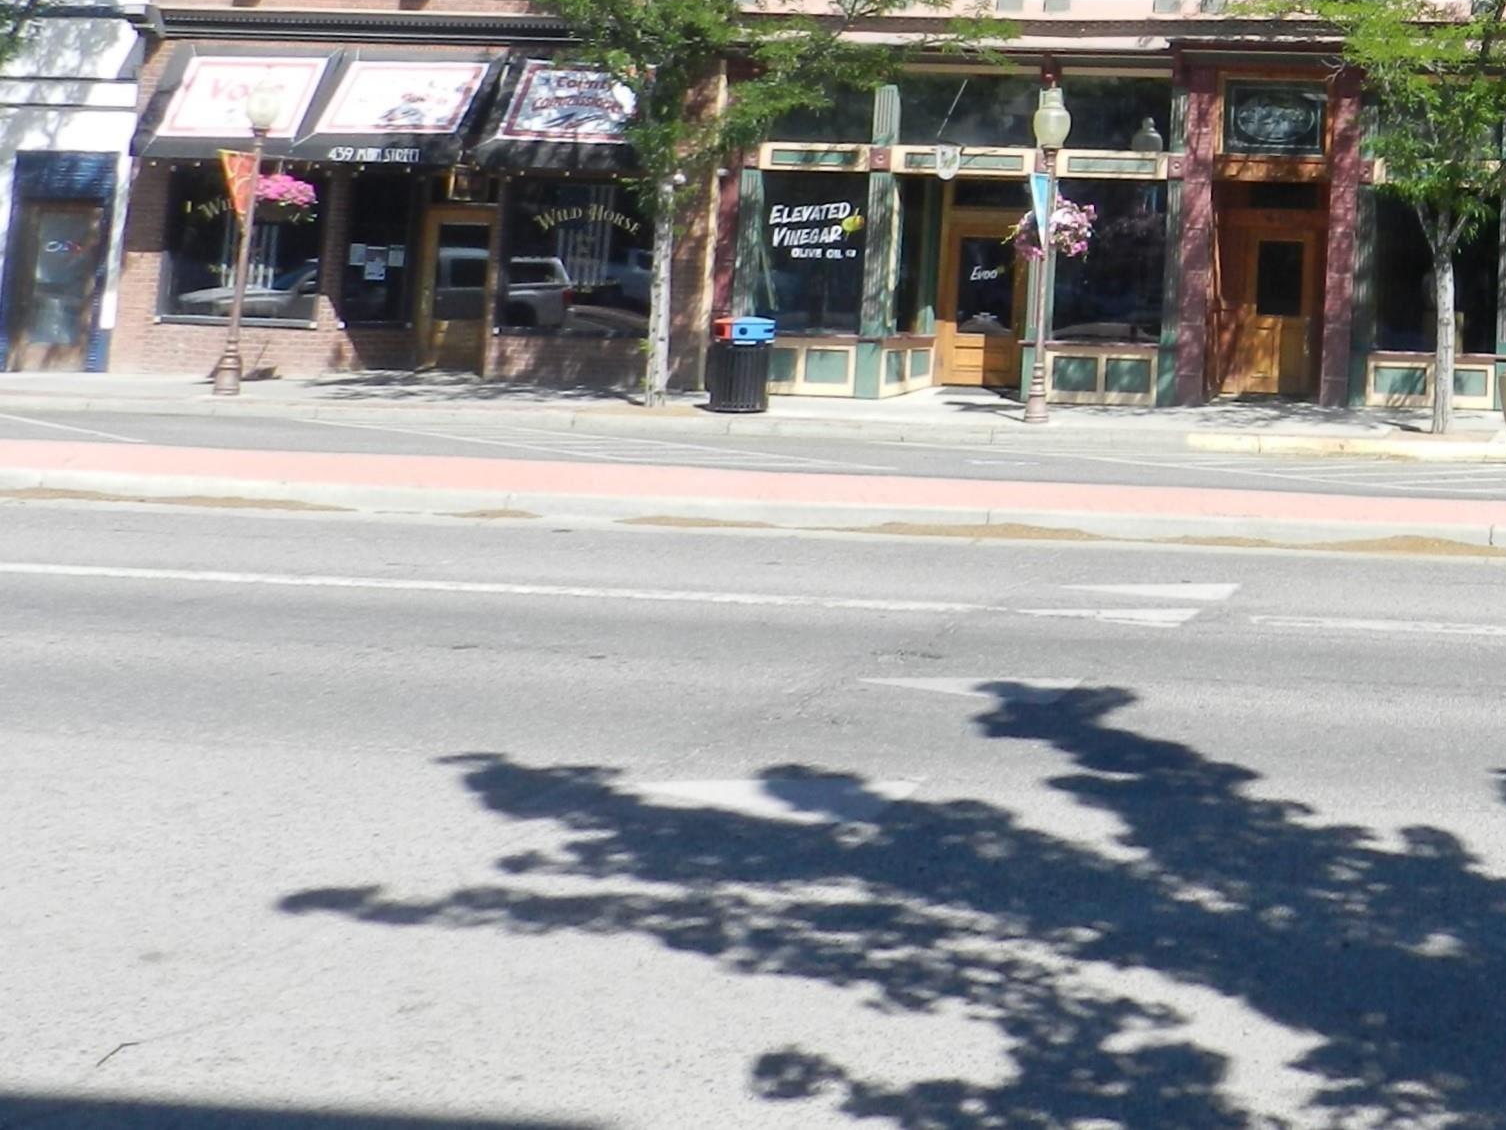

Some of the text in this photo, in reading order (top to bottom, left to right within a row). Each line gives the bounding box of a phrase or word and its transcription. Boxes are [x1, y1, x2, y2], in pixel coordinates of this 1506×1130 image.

[328, 147, 354, 161] 439
[383, 149, 420, 162] STREET
[533, 203, 640, 236] WILD HORSE
[769, 201, 851, 225] ELEVATED
[772, 225, 843, 247] VINEGAR
[791, 247, 822, 258] OLIVE
[826, 249, 843, 258] OIL
